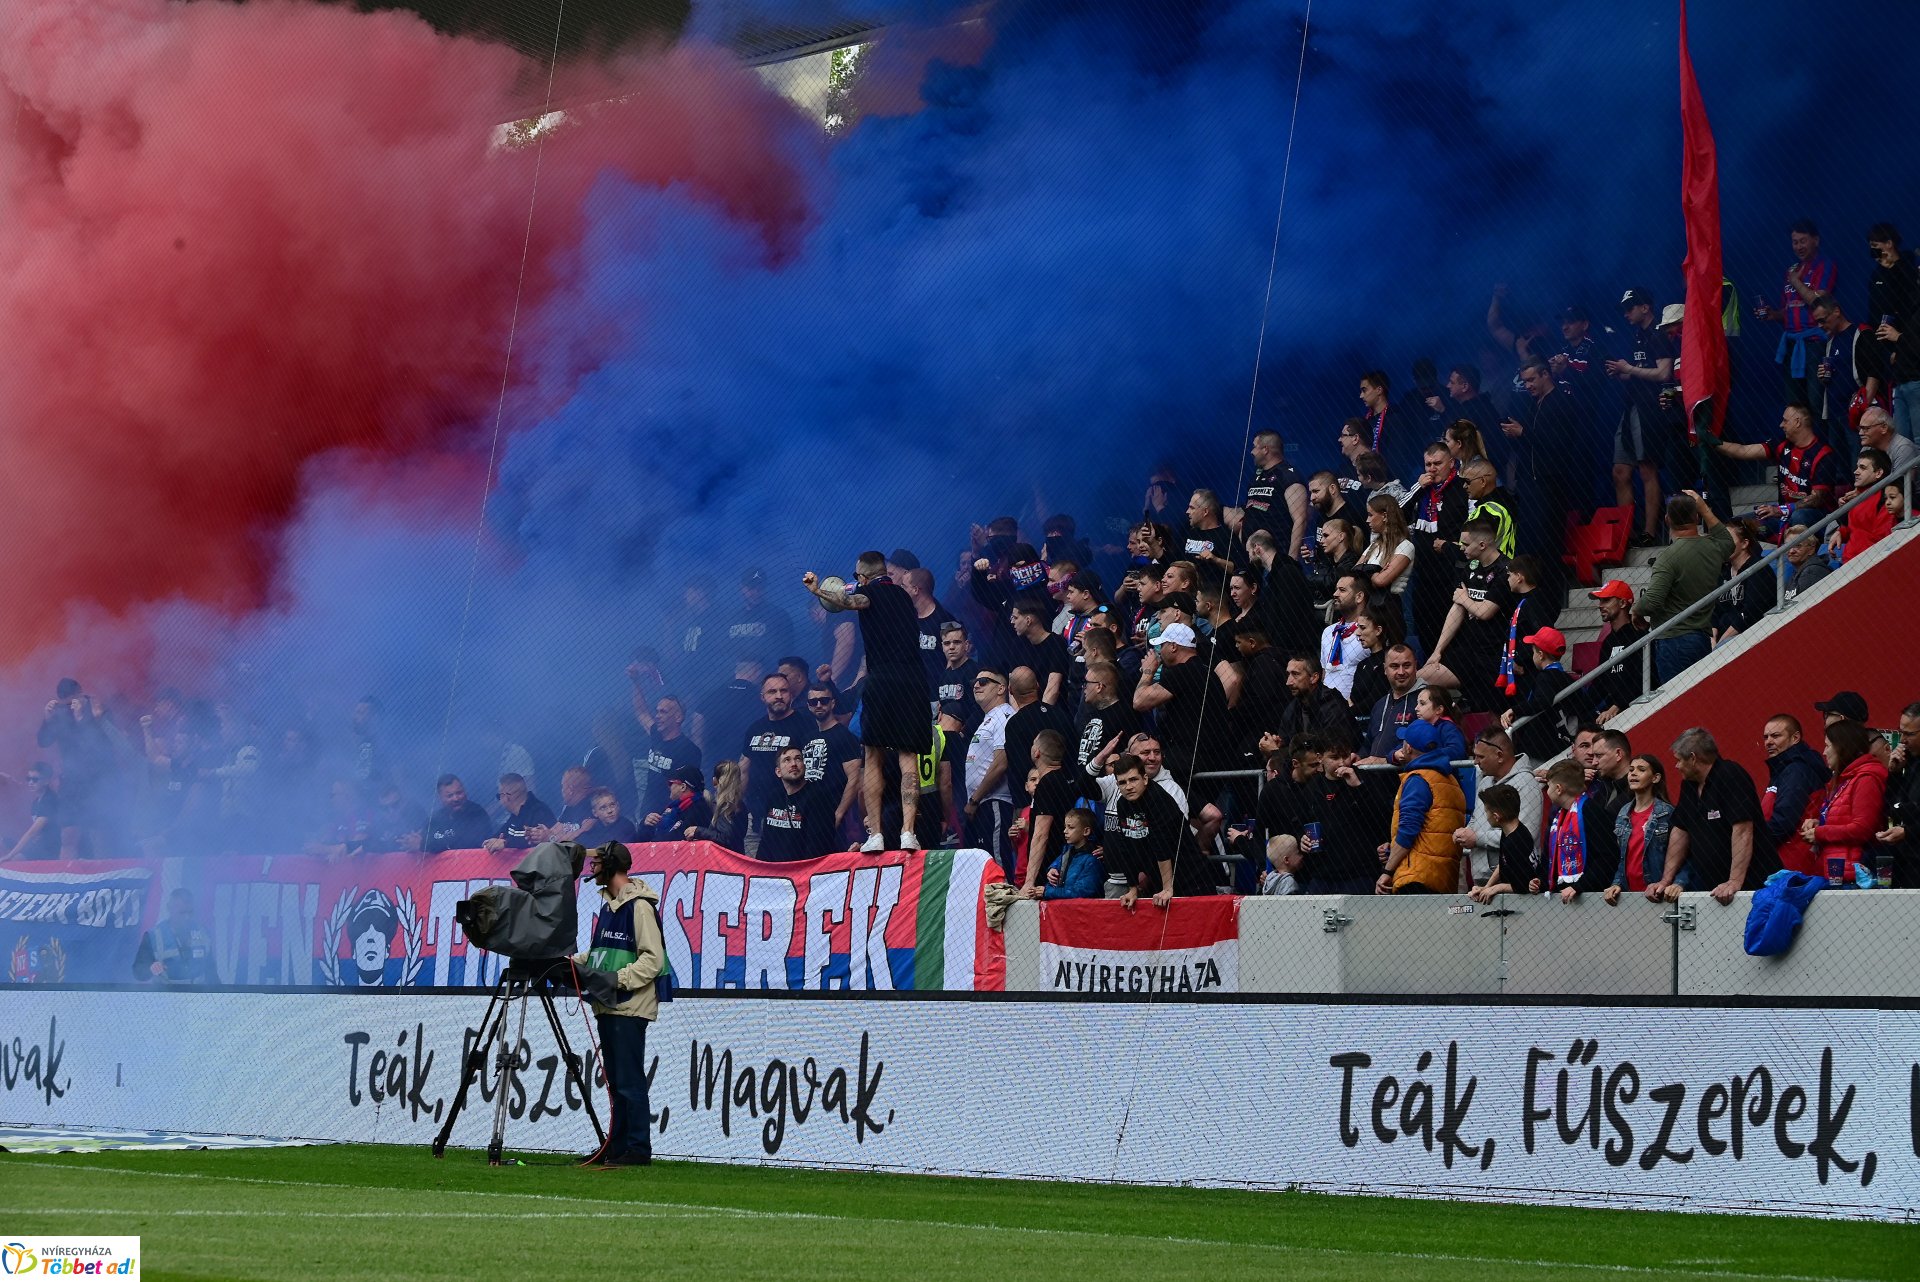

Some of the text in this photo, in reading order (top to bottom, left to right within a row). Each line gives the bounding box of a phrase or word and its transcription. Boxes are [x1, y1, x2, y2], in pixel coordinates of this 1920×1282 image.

[1611, 664, 1624, 674] AIR
[77, 888, 142, 929] BOYS
[213, 855, 321, 986] VÉN
[1054, 955, 1222, 992] NYÍREGYHÁZA
[0, 1015, 71, 1106] vak.
[344, 1022, 444, 1124] Teák,
[690, 1030, 895, 1154] Magvak.
[1330, 1040, 1495, 1170] Teák,
[1523, 1039, 1877, 1186] Fűszerek,
